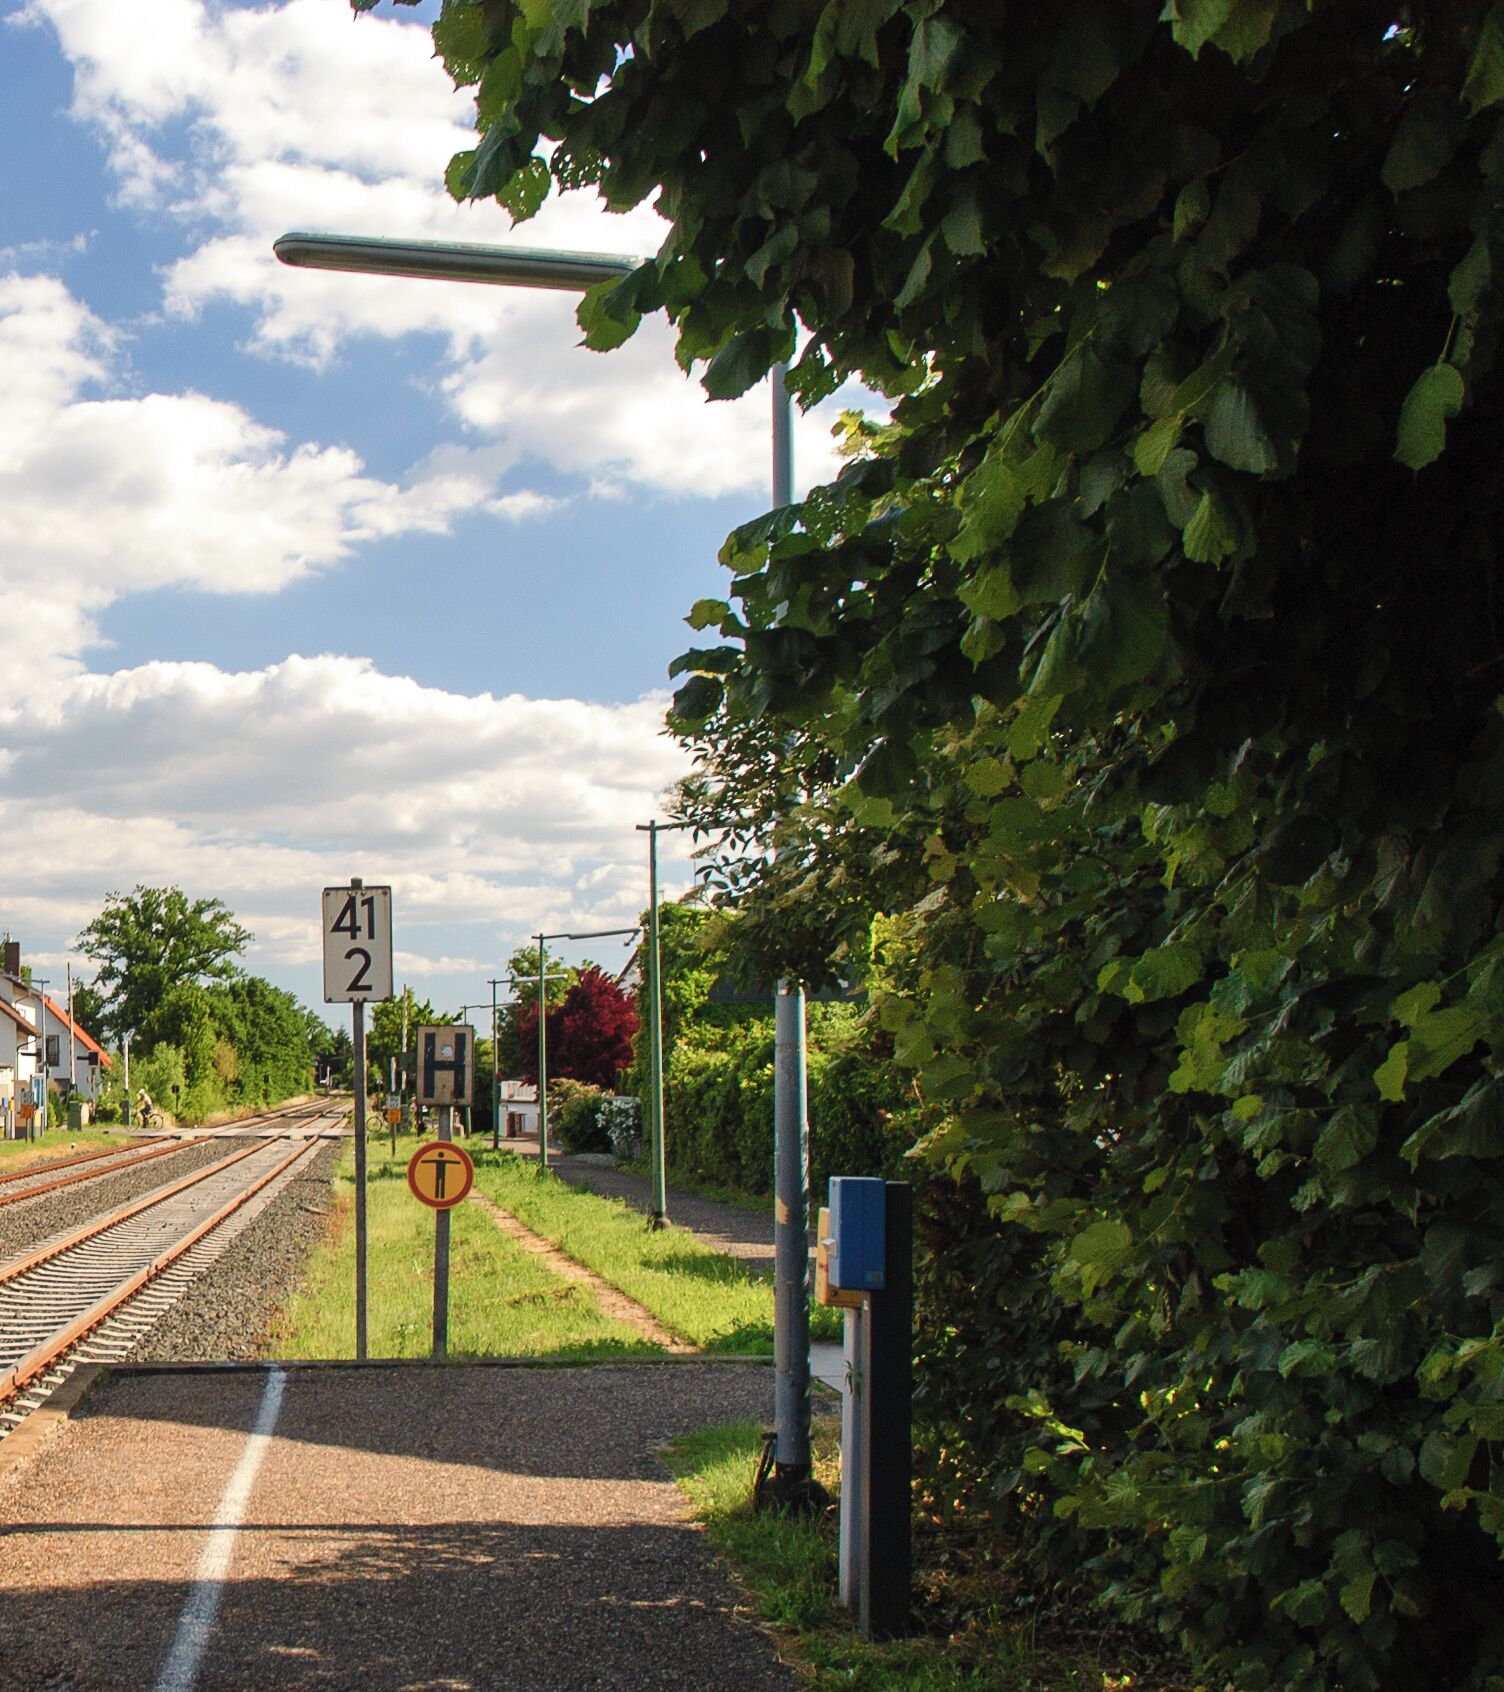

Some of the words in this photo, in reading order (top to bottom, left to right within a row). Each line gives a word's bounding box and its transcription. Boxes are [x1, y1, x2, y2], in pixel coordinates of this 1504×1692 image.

[330, 896, 375, 940] 41
[344, 947, 373, 992] 2
[424, 1032, 466, 1099] H
